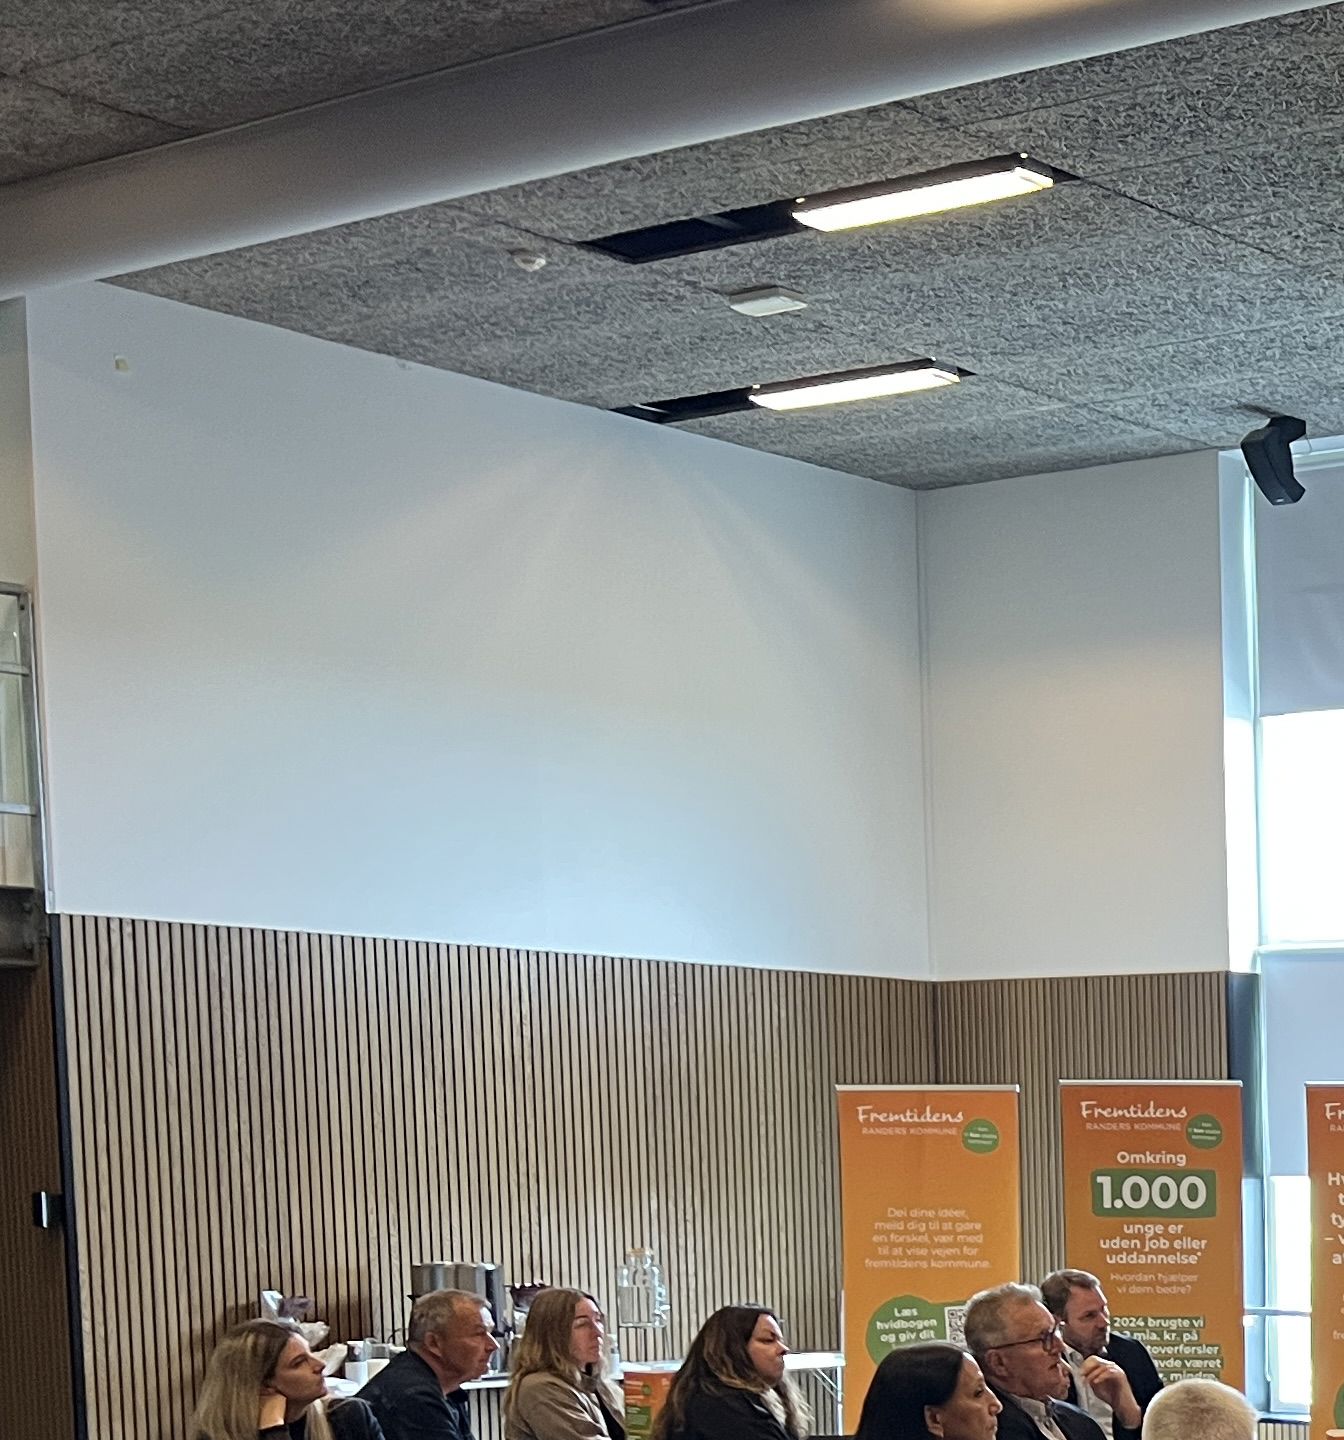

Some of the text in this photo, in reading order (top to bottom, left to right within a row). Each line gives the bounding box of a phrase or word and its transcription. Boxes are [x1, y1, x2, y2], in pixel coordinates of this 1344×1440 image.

[857, 1105, 964, 1124] Fremtidens
[1080, 1101, 1188, 1119] Fremtidens
[1117, 1151, 1186, 1166] Omkring
[1097, 1175, 1207, 1209] 1.000
[1124, 1224, 1183, 1236] unge er
[1100, 1235, 1207, 1251] uden job eller
[1114, 1317, 1204, 1329] 2024 brugte vi
[1183, 1330, 1198, 1342] på
